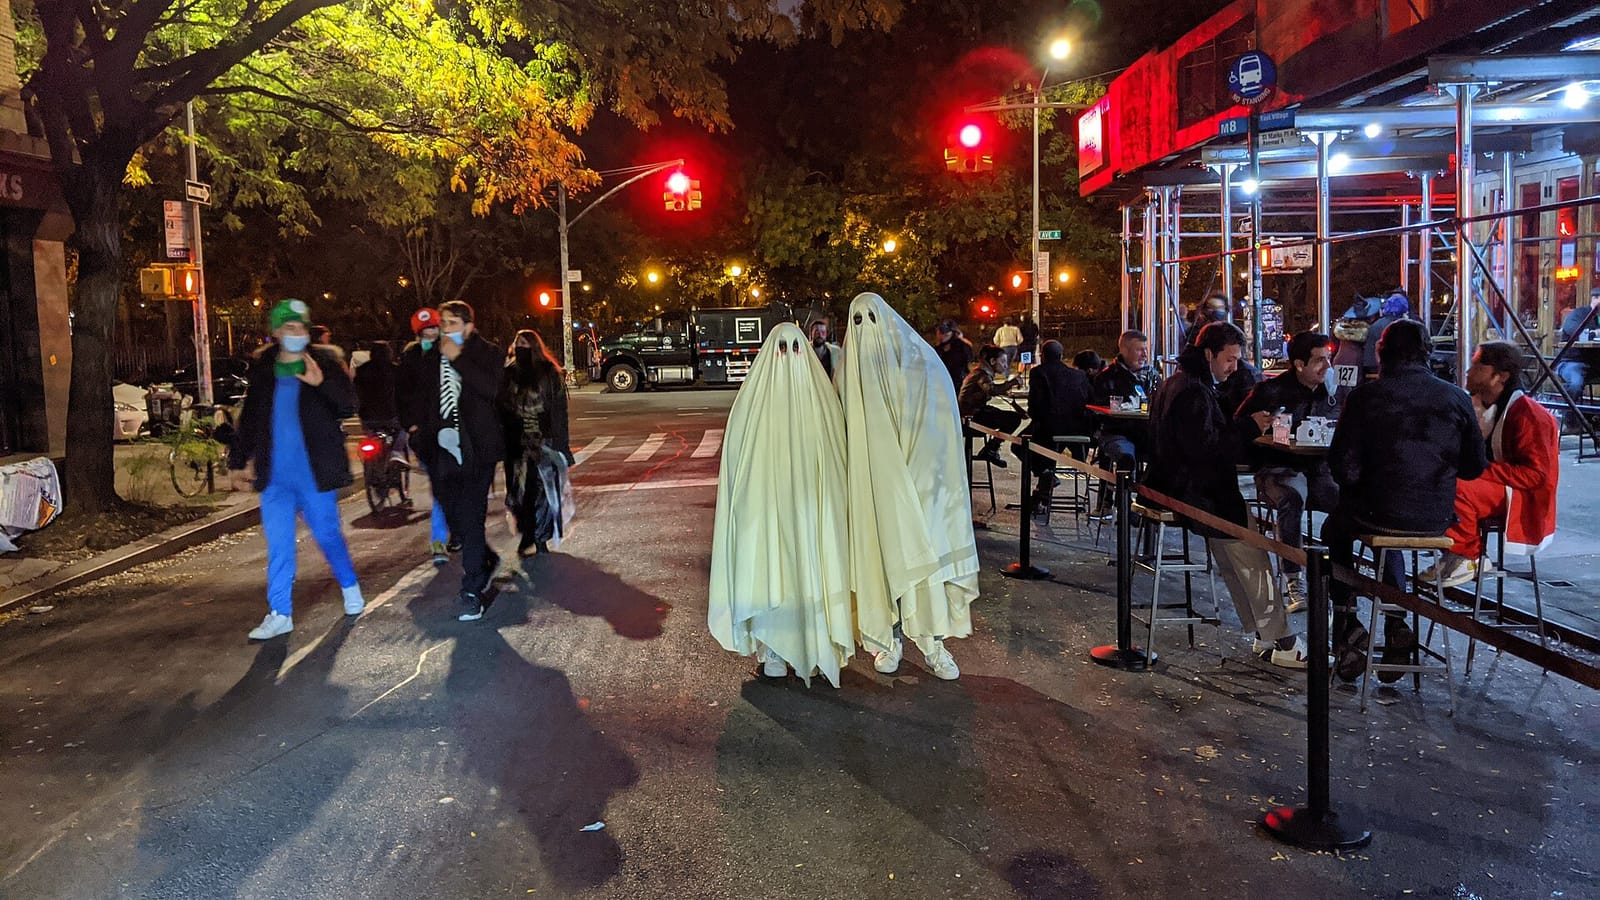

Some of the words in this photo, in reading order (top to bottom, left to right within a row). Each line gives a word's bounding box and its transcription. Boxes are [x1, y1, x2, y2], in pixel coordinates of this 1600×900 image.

[1232, 93, 1241, 103] NO
[1241, 87, 1271, 105] STANDING
[1221, 120, 1237, 134] M8
[1338, 367, 1354, 381] 127
